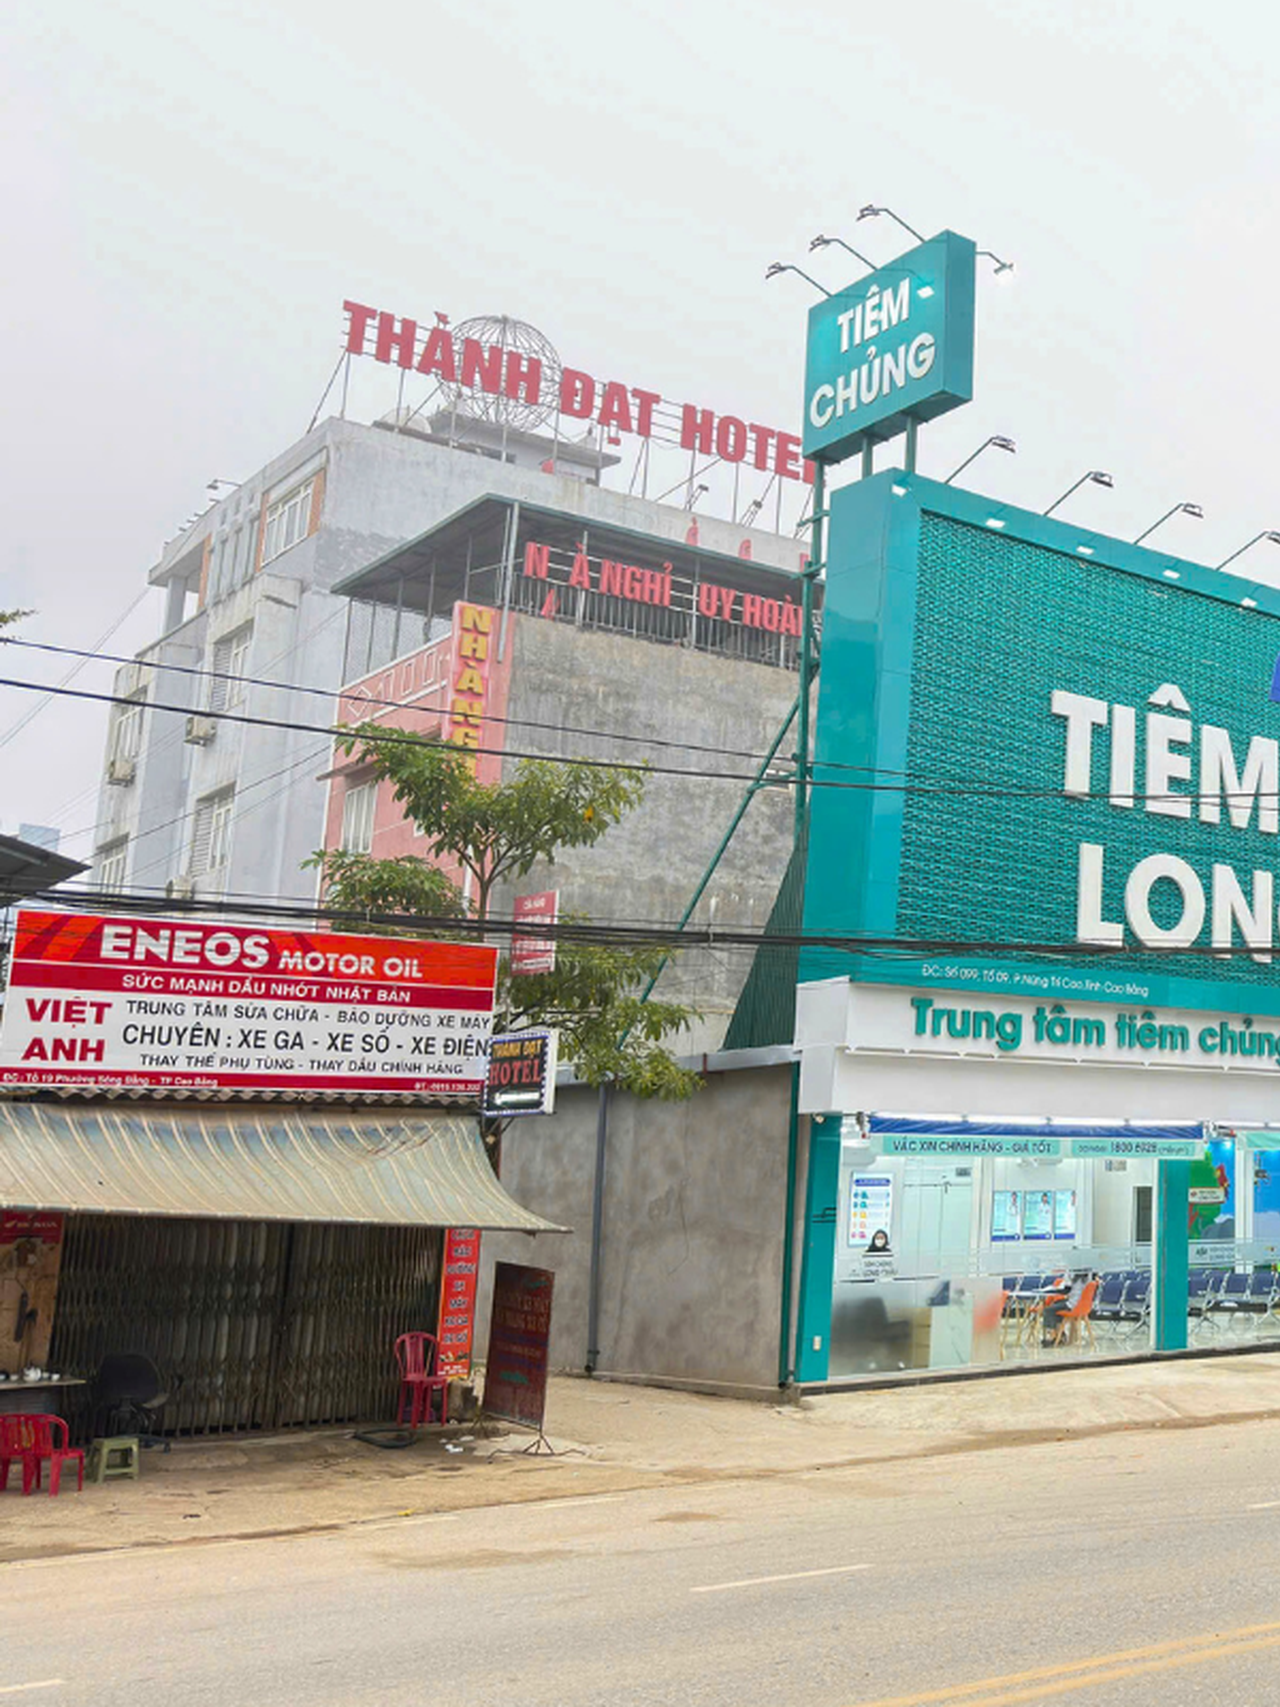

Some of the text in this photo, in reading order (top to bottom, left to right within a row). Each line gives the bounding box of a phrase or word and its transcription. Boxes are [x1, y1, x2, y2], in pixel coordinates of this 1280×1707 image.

[837, 276, 911, 354] TIÊM
[343, 299, 543, 406] THÀNH
[558, 366, 662, 446] ĐẠT
[809, 332, 936, 430] CHỦNG
[1051, 682, 1280, 835] TIÊM
[100, 924, 423, 979] ENEOS MOTOR OIL
[122, 973, 165, 990] SỨC
[169, 978, 224, 995] MẠNH
[325, 983, 372, 1003] NHẬT
[25, 996, 113, 1028] VIỆT
[126, 1000, 186, 1017] TRUNG
[193, 1000, 228, 1018] TÂM
[436, 1015, 455, 1027] XE
[460, 1014, 490, 1030] MÁY
[910, 997, 1023, 1050] Trung
[1032, 1005, 1106, 1047] tâm
[1115, 1010, 1190, 1052] tiêm
[22, 1037, 105, 1062] ANH
[122, 1022, 220, 1048] CHUYÊN
[238, 1029, 266, 1050] XE
[274, 1031, 304, 1051] GA
[326, 1033, 354, 1052] XE
[361, 1026, 390, 1053] SỐ
[410, 1036, 436, 1055] XE
[443, 1034, 490, 1061] ĐIỆN
[140, 1054, 180, 1067] THAY
[309, 1059, 344, 1072] THAY
[488, 1058, 542, 1086] HOTEL
